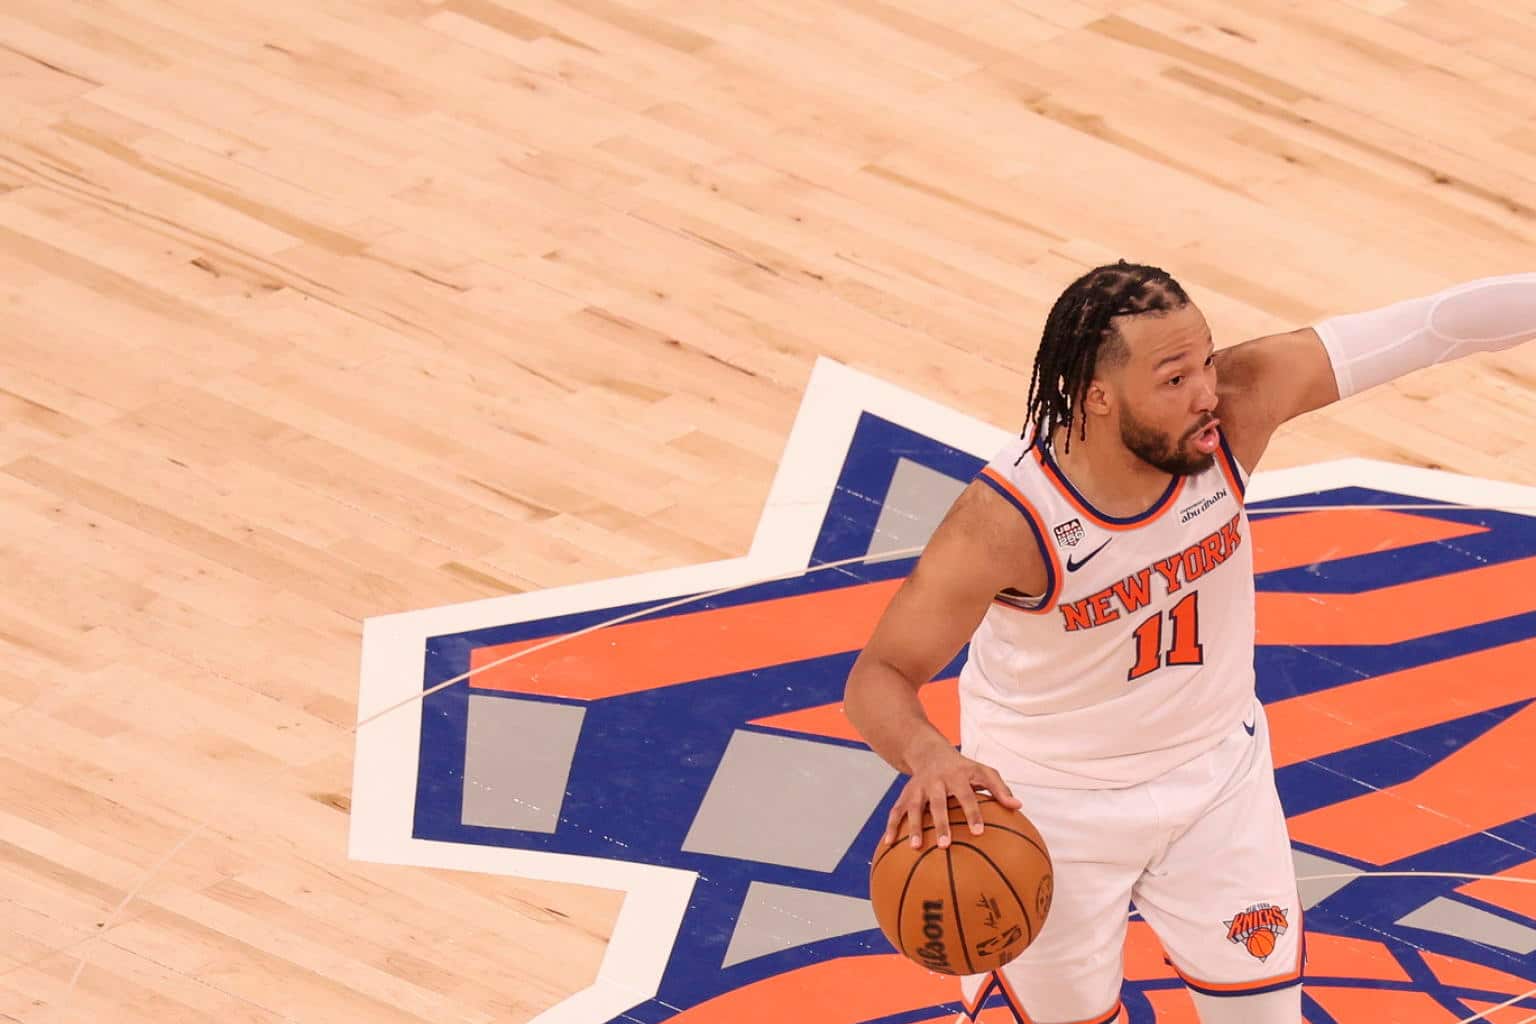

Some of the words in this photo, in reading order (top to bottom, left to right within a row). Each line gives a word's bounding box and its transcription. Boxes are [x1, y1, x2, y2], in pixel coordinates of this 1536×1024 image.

[1059, 567, 1152, 633] NEW
[1154, 513, 1242, 595] YORK
[1127, 590, 1204, 682] 11
[916, 898, 953, 973] ilson
[1226, 905, 1288, 944] KNICKS
